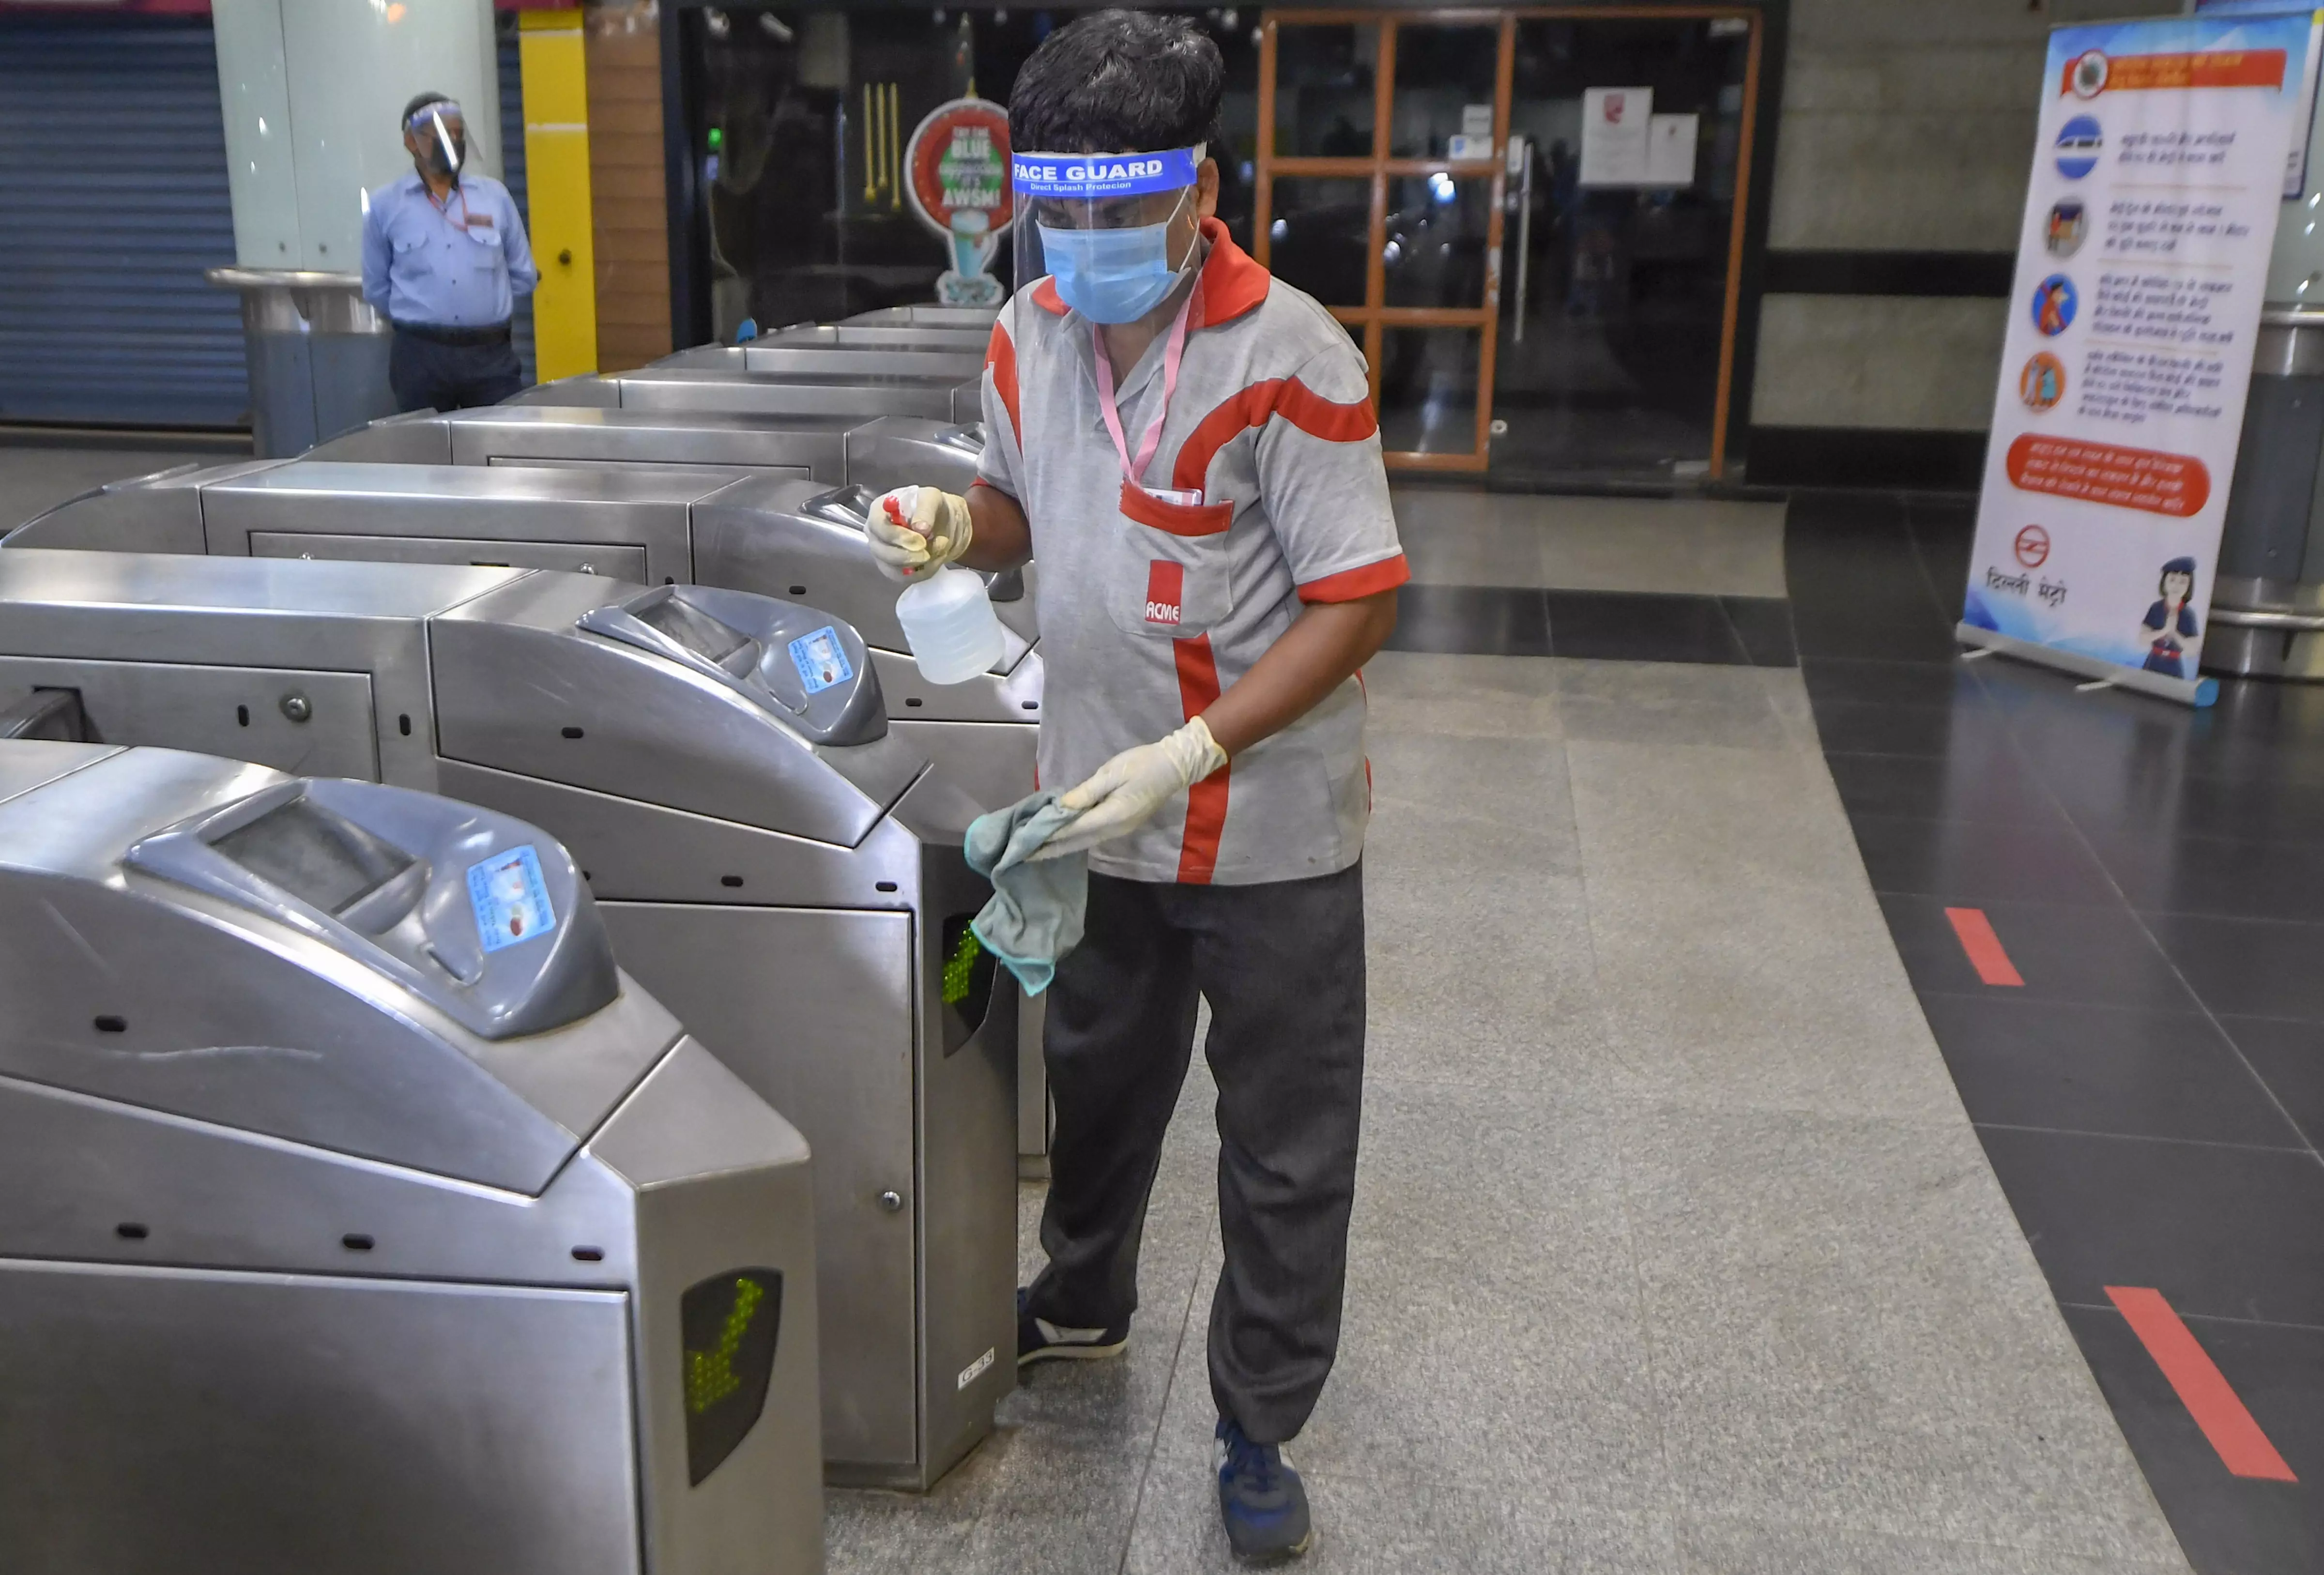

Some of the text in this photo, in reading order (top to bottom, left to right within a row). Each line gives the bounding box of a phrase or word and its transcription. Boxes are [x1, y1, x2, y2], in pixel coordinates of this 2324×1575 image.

[951, 139, 991, 159] BLUE
[1014, 163, 1057, 180] FACE
[1066, 160, 1162, 181] GUARD
[1030, 181, 1131, 192] Direct Splash Protecion
[1146, 601, 1180, 621] ACME
